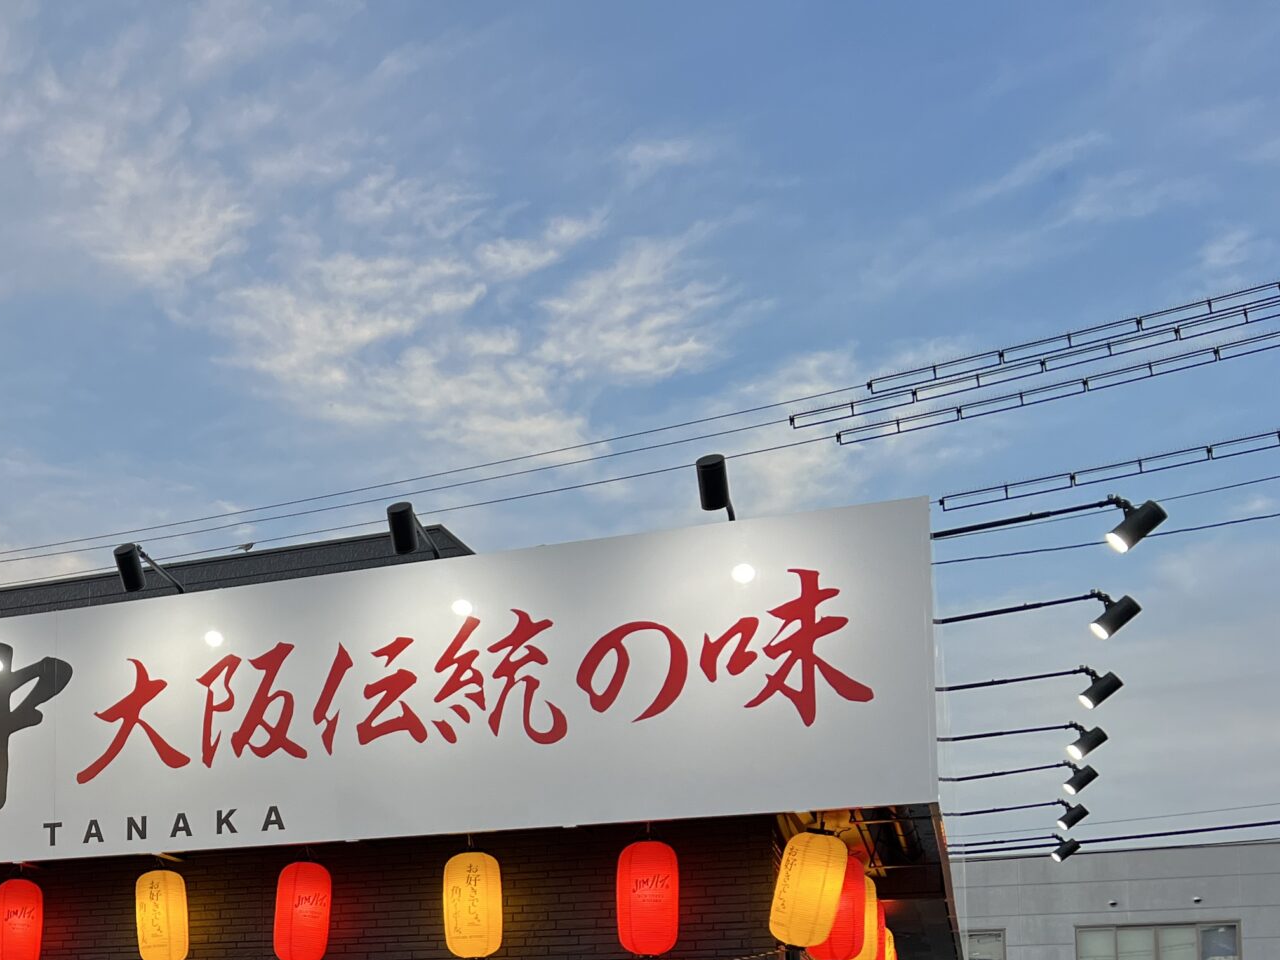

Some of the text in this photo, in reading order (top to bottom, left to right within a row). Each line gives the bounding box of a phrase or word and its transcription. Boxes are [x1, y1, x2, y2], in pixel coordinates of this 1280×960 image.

[75, 568, 874, 786] 大阪伝統の味
[43, 804, 288, 847] TANAKA
